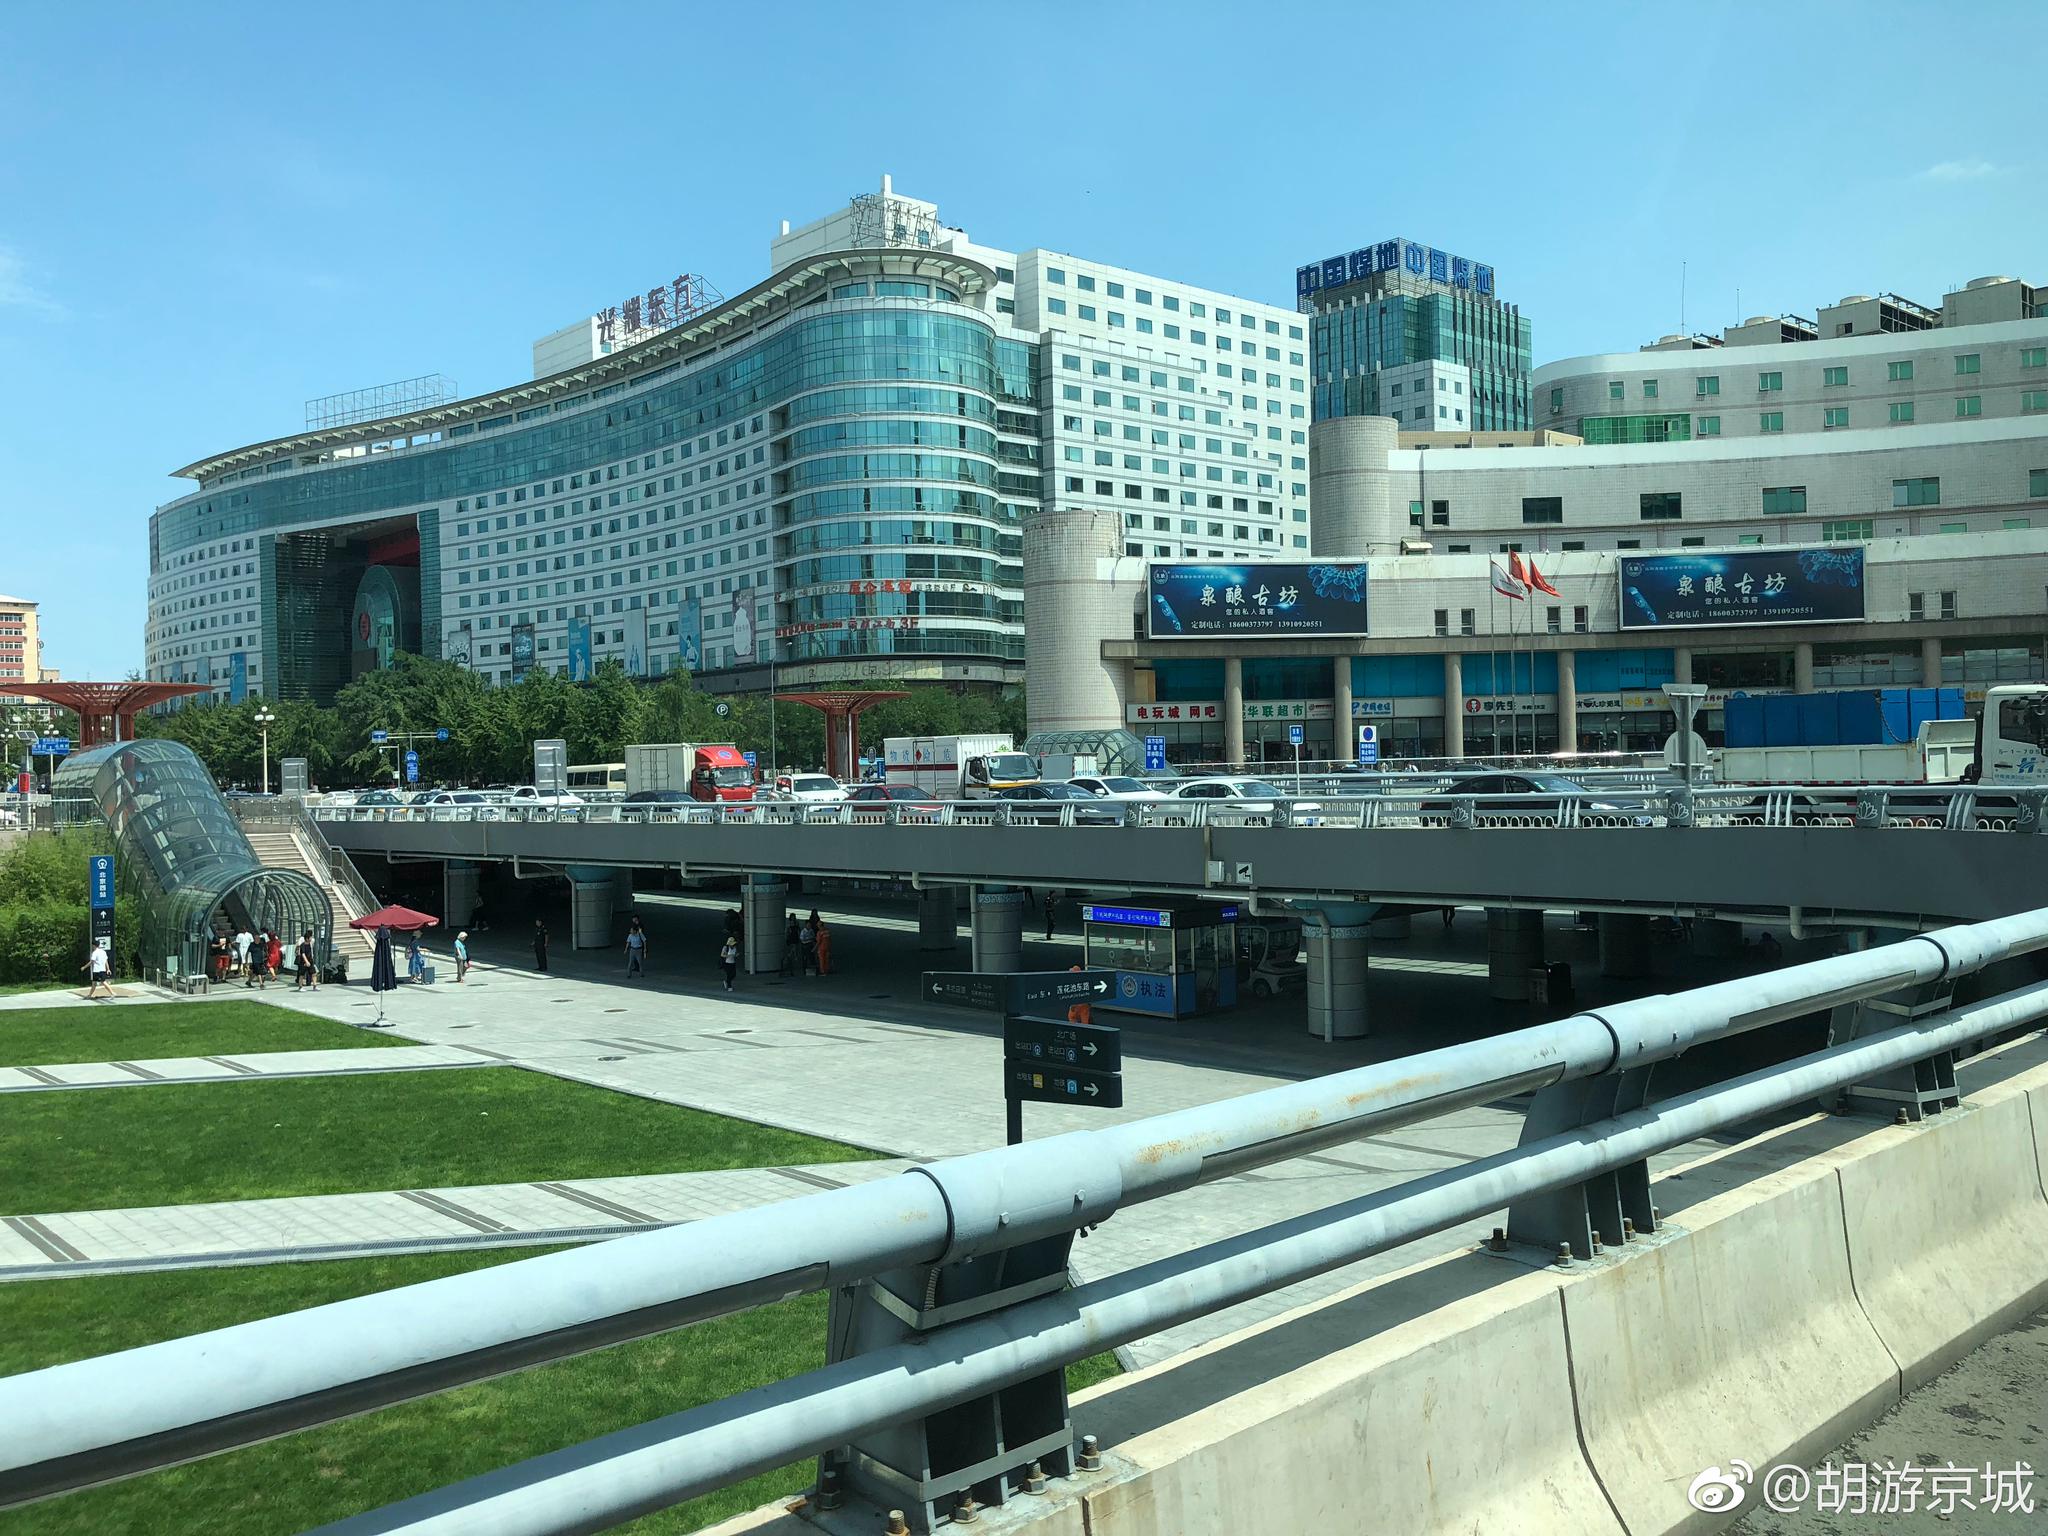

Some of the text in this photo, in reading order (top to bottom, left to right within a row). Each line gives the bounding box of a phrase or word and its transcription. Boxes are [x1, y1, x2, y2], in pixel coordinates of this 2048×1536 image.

[1297, 241, 1399, 296] 中国煤地
[1406, 243, 1492, 296] 中国煤地
[1199, 584, 1301, 607] 泉酿古坊
[1676, 572, 1788, 597] 泉酿古坊
[1137, 705, 1217, 719] 电玩城 网吧
[1056, 982, 1090, 996] 莲花池东路
[1140, 980, 1167, 998] 执法
